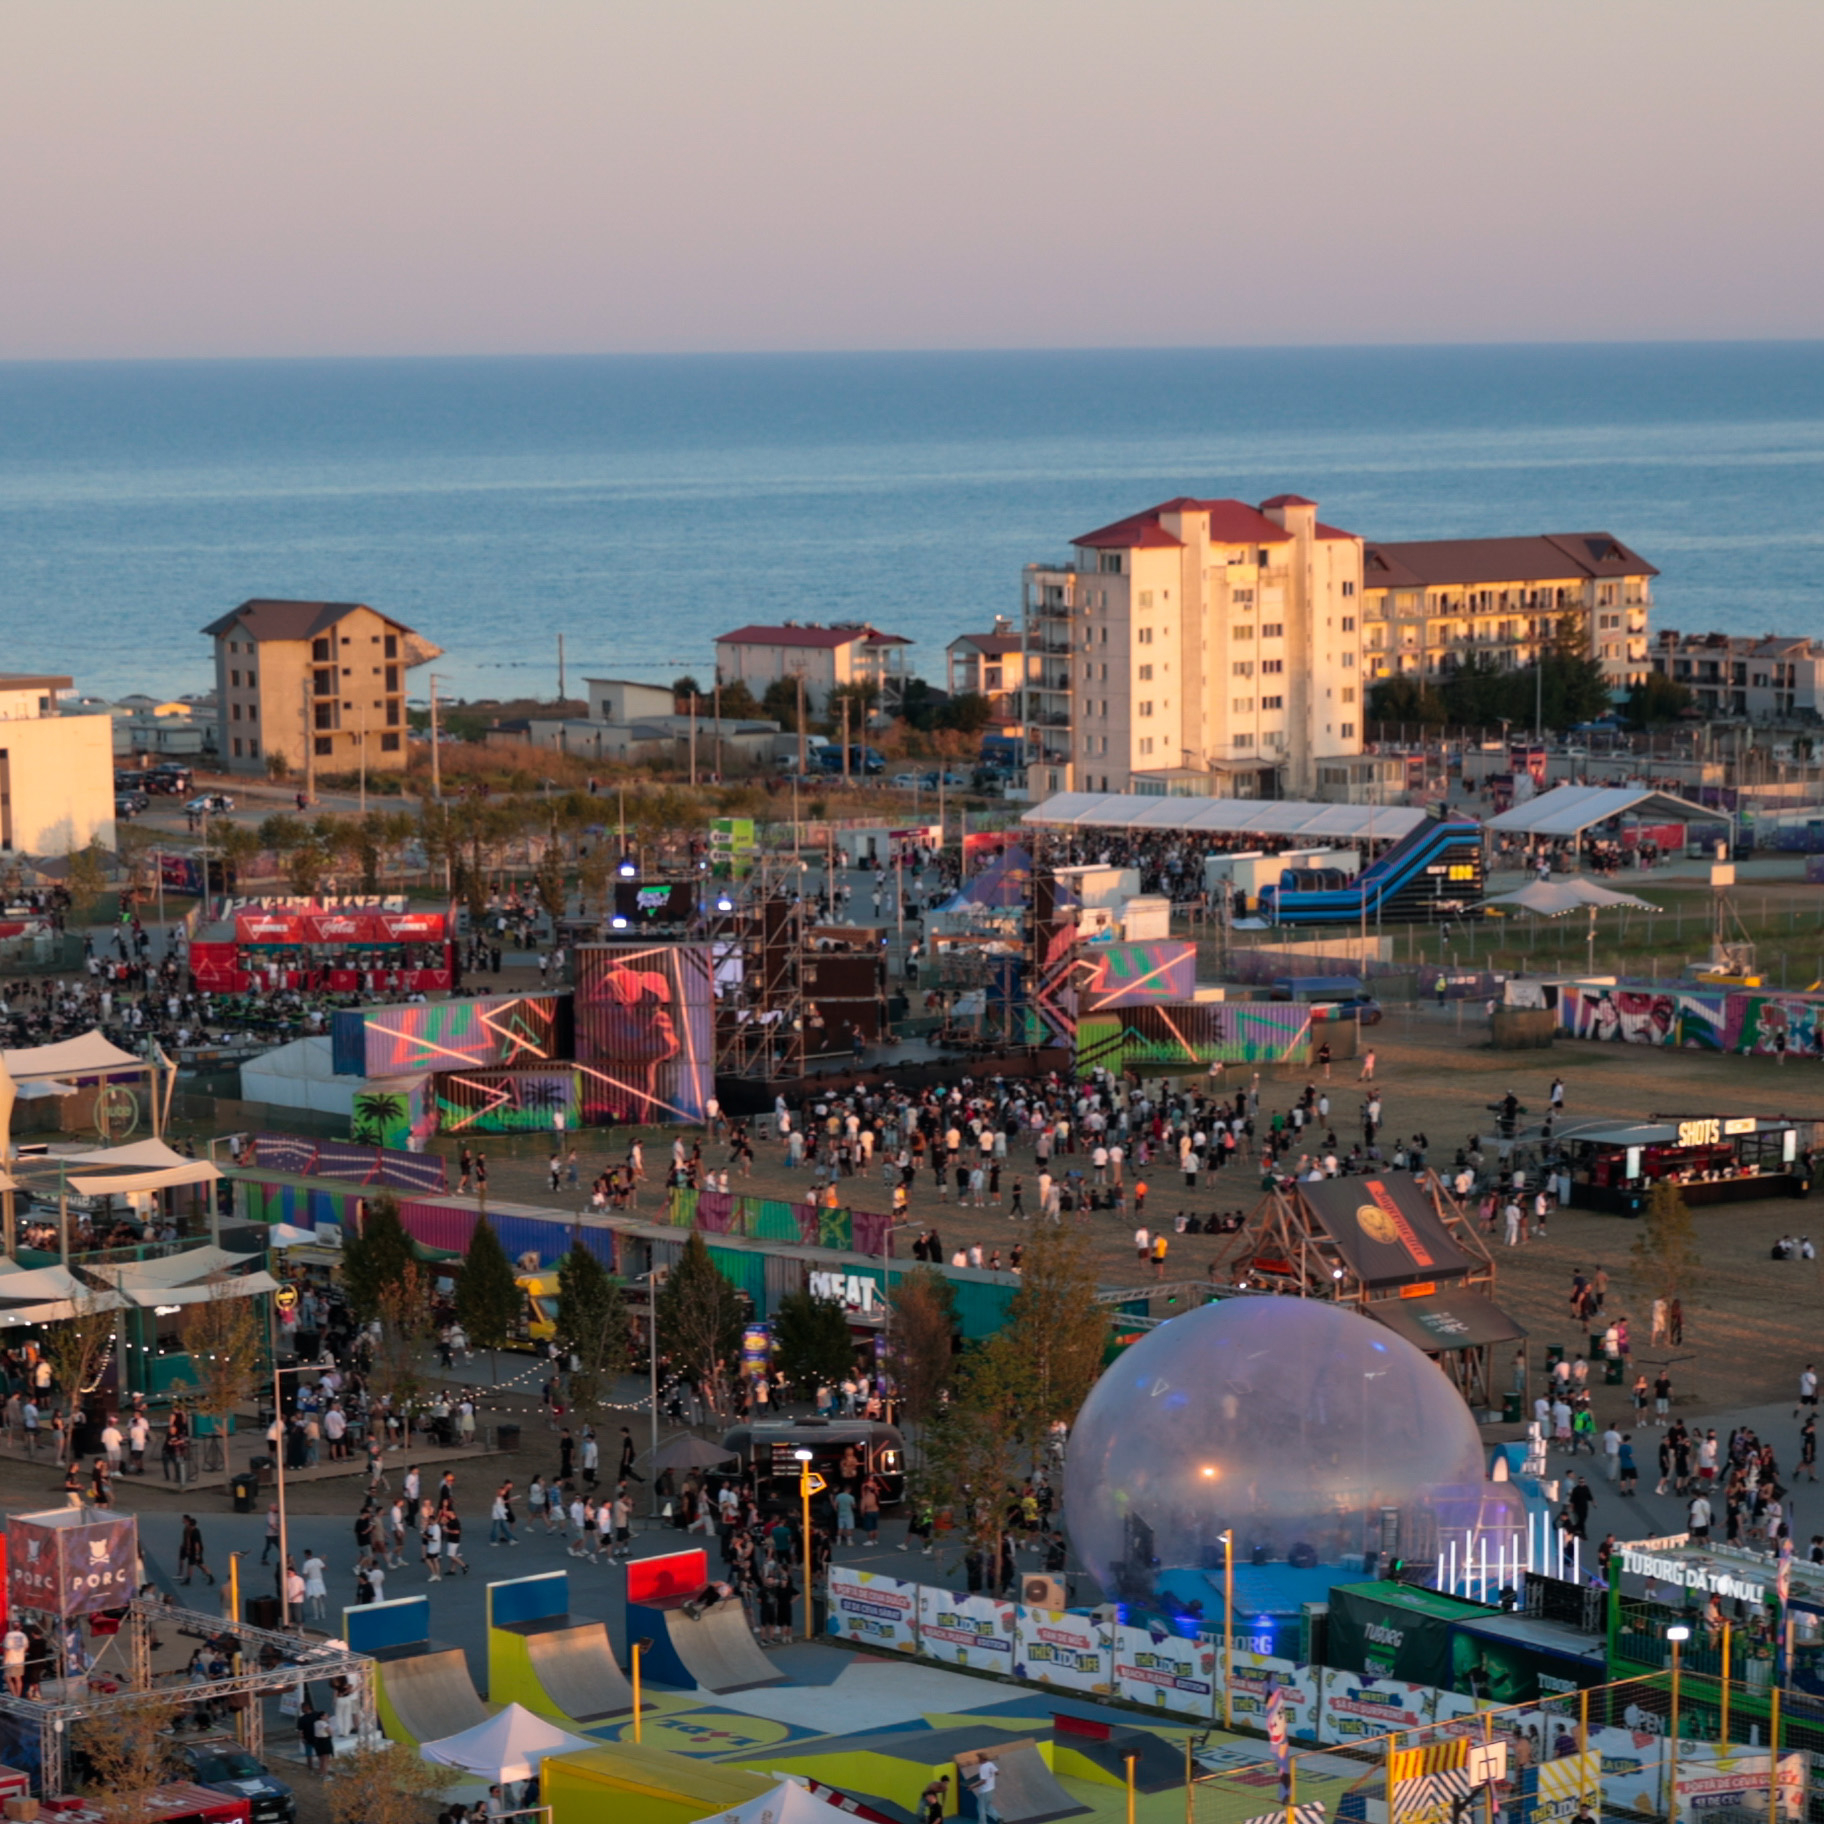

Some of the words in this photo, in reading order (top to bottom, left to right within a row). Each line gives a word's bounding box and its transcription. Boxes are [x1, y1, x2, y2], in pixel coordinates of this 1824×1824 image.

[1678, 1117, 1720, 1148] SHOTS
[809, 1271, 877, 1312] MEAT
[13, 1568, 54, 1592] PORC
[72, 1568, 127, 1592] PORC
[1620, 1548, 1685, 1588] TUBORG
[1686, 1566, 1709, 1591] DĂ
[1193, 1631, 1274, 1657] TUORG
[1364, 1622, 1405, 1648] TUBORG
[1029, 1644, 1053, 1661] THIS
[1079, 1654, 1100, 1672] LIFE
[1530, 1803, 1555, 1824] THIS
